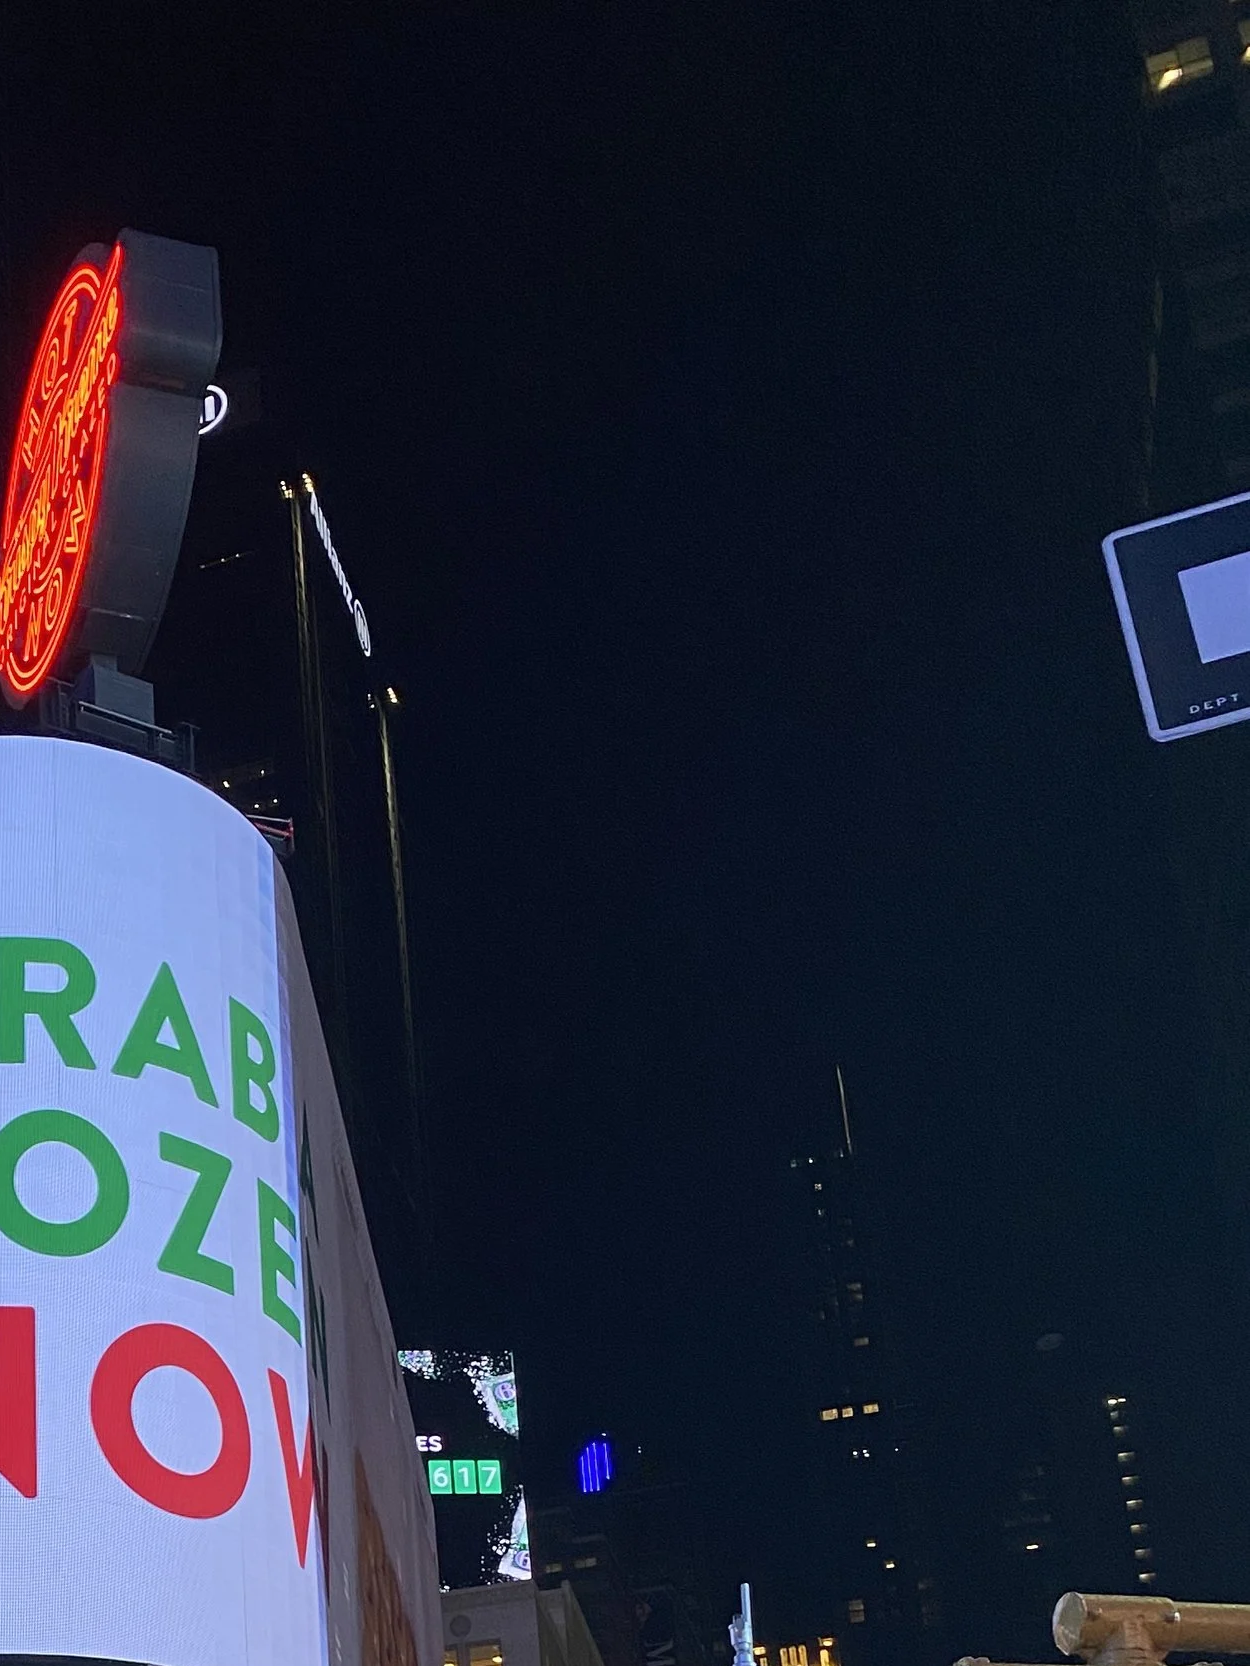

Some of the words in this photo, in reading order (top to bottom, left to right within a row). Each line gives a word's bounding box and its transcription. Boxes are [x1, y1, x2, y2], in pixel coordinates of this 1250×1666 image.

[21, 297, 79, 473] HOT
[62, 350, 119, 499] GLAZED
[23, 479, 89, 663] NOW
[309, 489, 354, 615] Allianz
[1189, 693, 1239, 715] DEPT
[433, 1466, 498, 1488] 617
